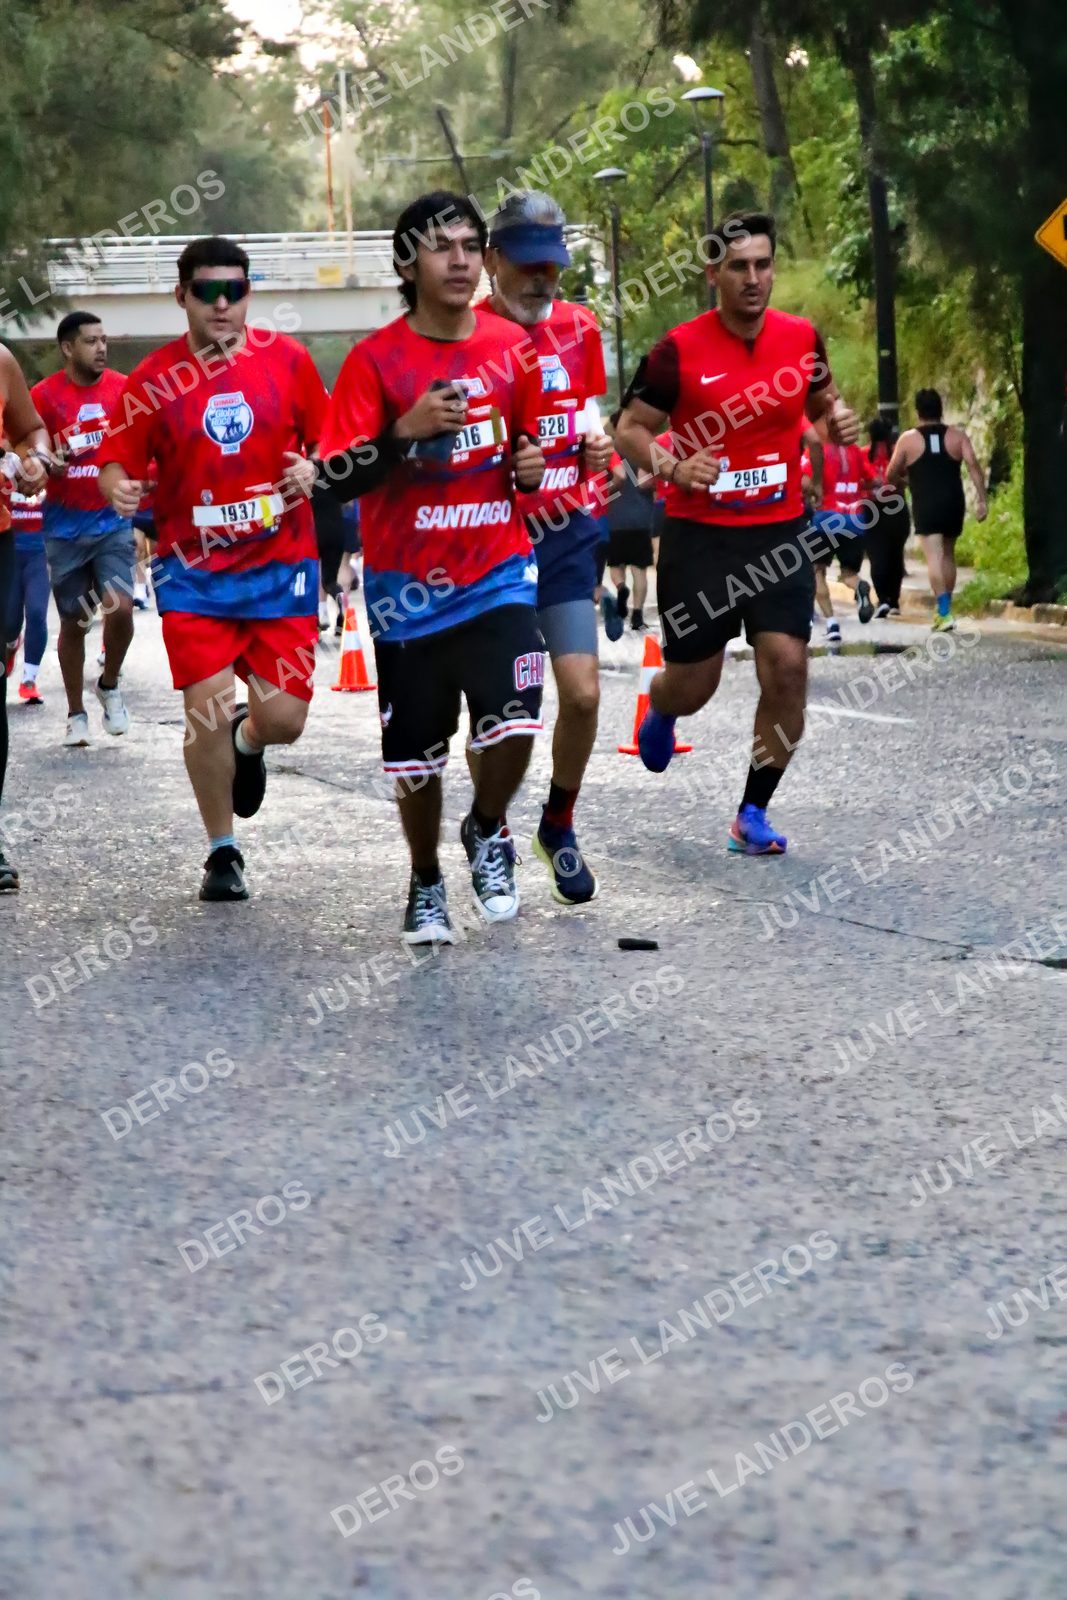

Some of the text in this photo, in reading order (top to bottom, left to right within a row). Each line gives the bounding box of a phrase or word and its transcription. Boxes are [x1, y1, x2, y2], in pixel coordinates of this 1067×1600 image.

[538, 416, 565, 437] 628
[734, 469, 768, 489] 2964
[221, 501, 256, 523] 1937
[415, 500, 512, 529] SANTIAGO
